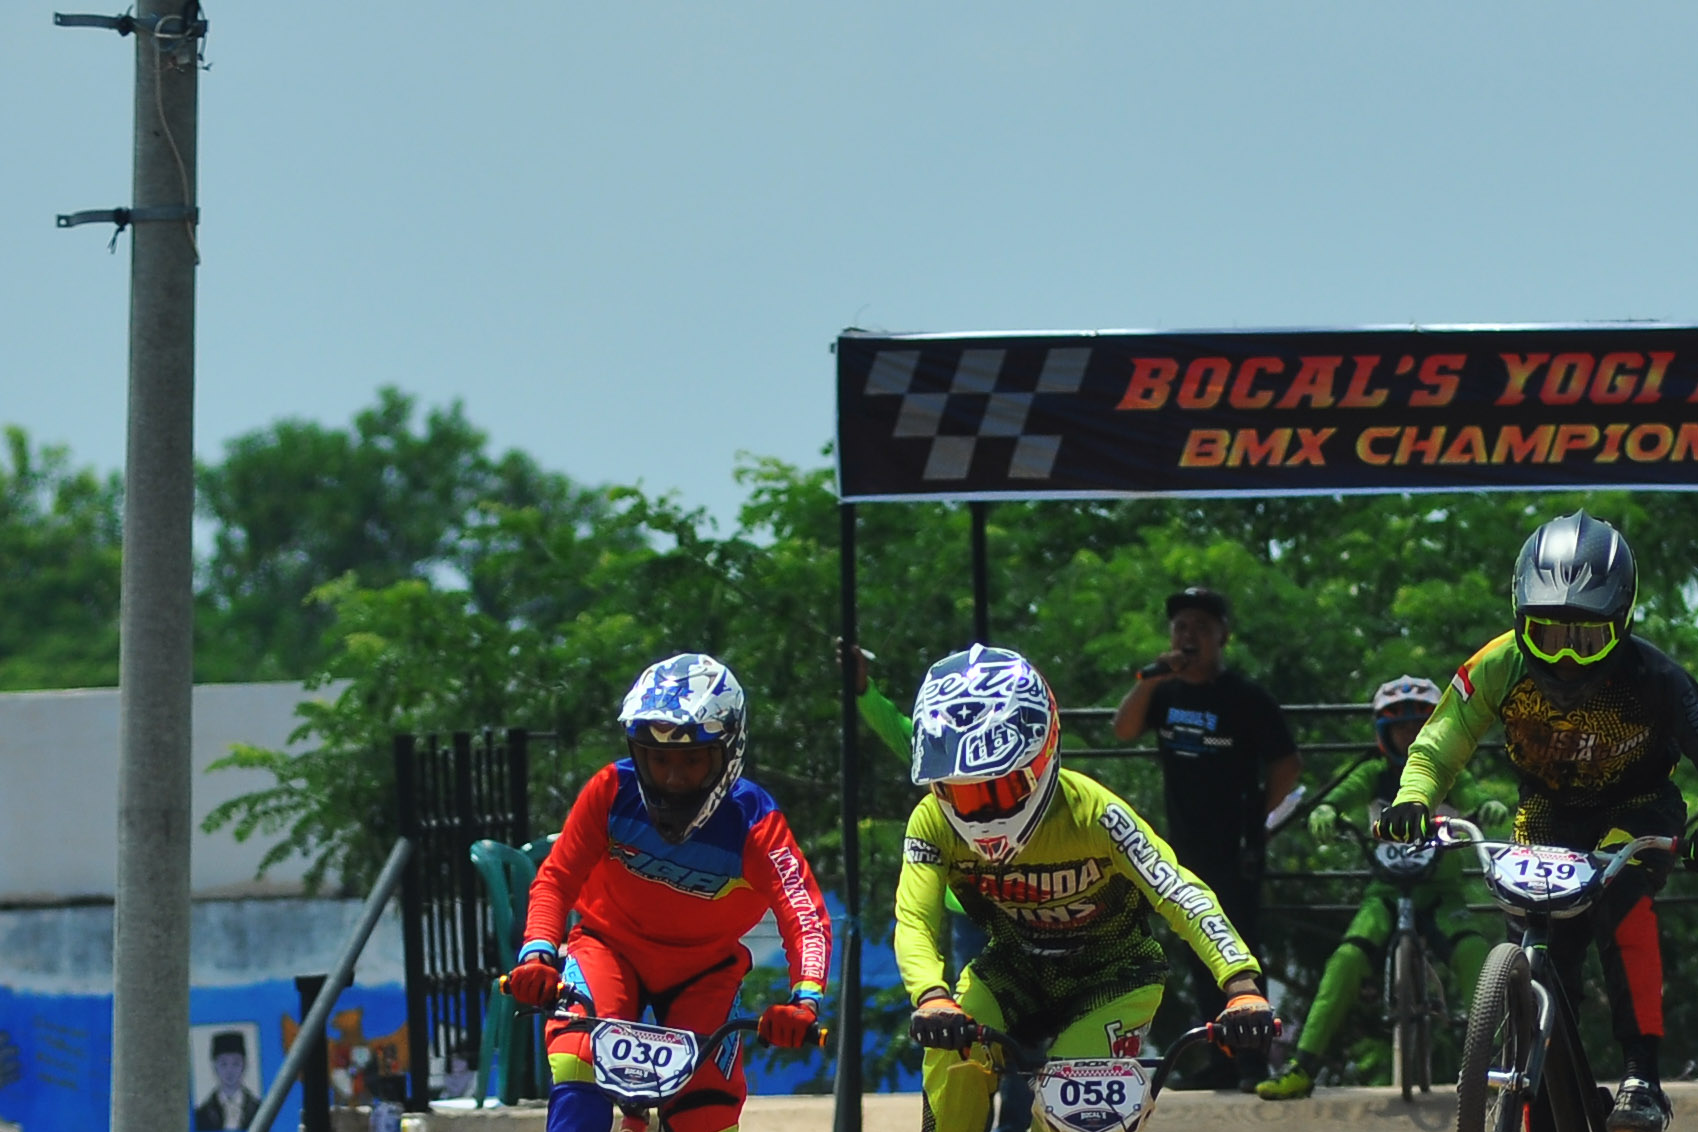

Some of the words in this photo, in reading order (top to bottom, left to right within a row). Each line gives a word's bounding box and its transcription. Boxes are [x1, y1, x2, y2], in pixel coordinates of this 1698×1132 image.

[1114, 354, 1467, 411] BOCAL'S
[1494, 351, 1676, 406] YOGI
[1179, 427, 1338, 467] BMX
[1515, 859, 1576, 881] 159
[612, 1038, 673, 1068] 030
[1060, 1080, 1126, 1106] 058
